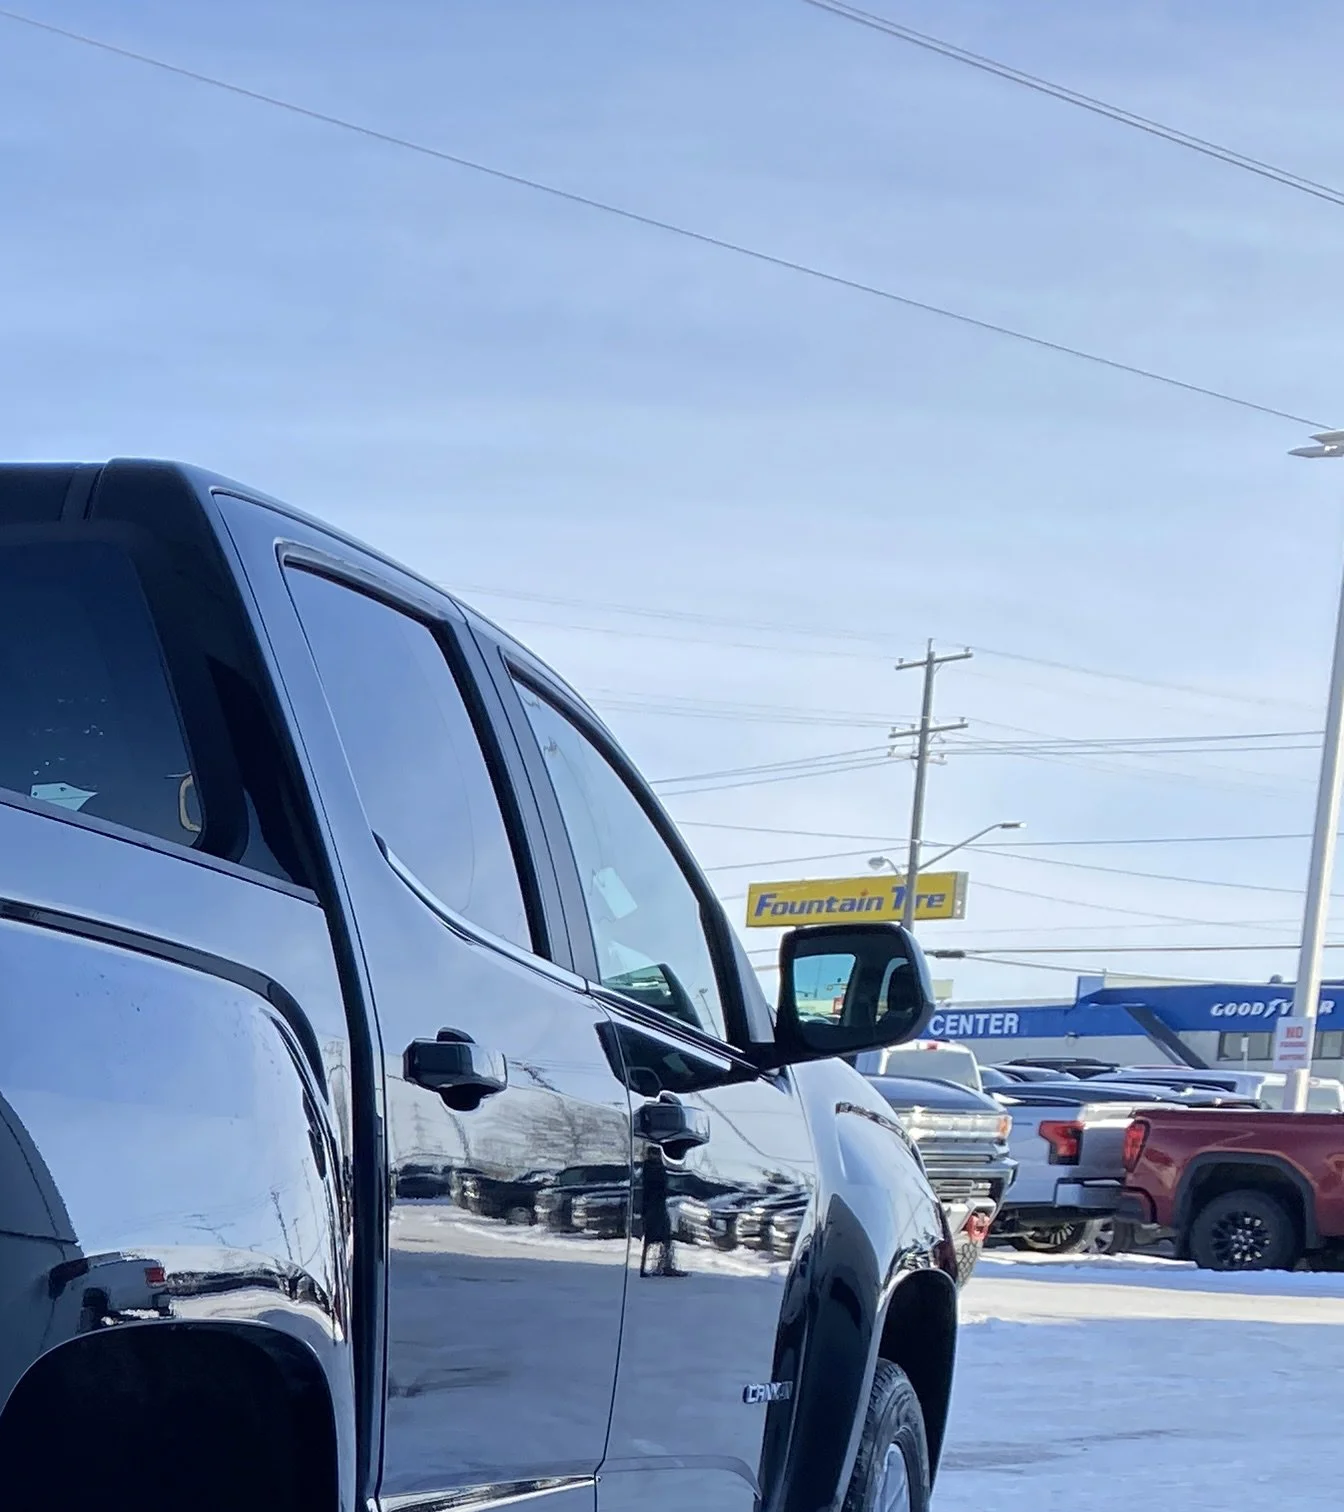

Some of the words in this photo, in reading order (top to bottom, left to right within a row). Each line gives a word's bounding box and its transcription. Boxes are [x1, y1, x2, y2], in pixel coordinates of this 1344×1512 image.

[754, 892, 884, 917] Fountain
[891, 885, 946, 911] Tre
[1210, 998, 1335, 1018] GOODYR
[929, 1011, 1019, 1036] CENTER
[1286, 1026, 1303, 1039] NO
